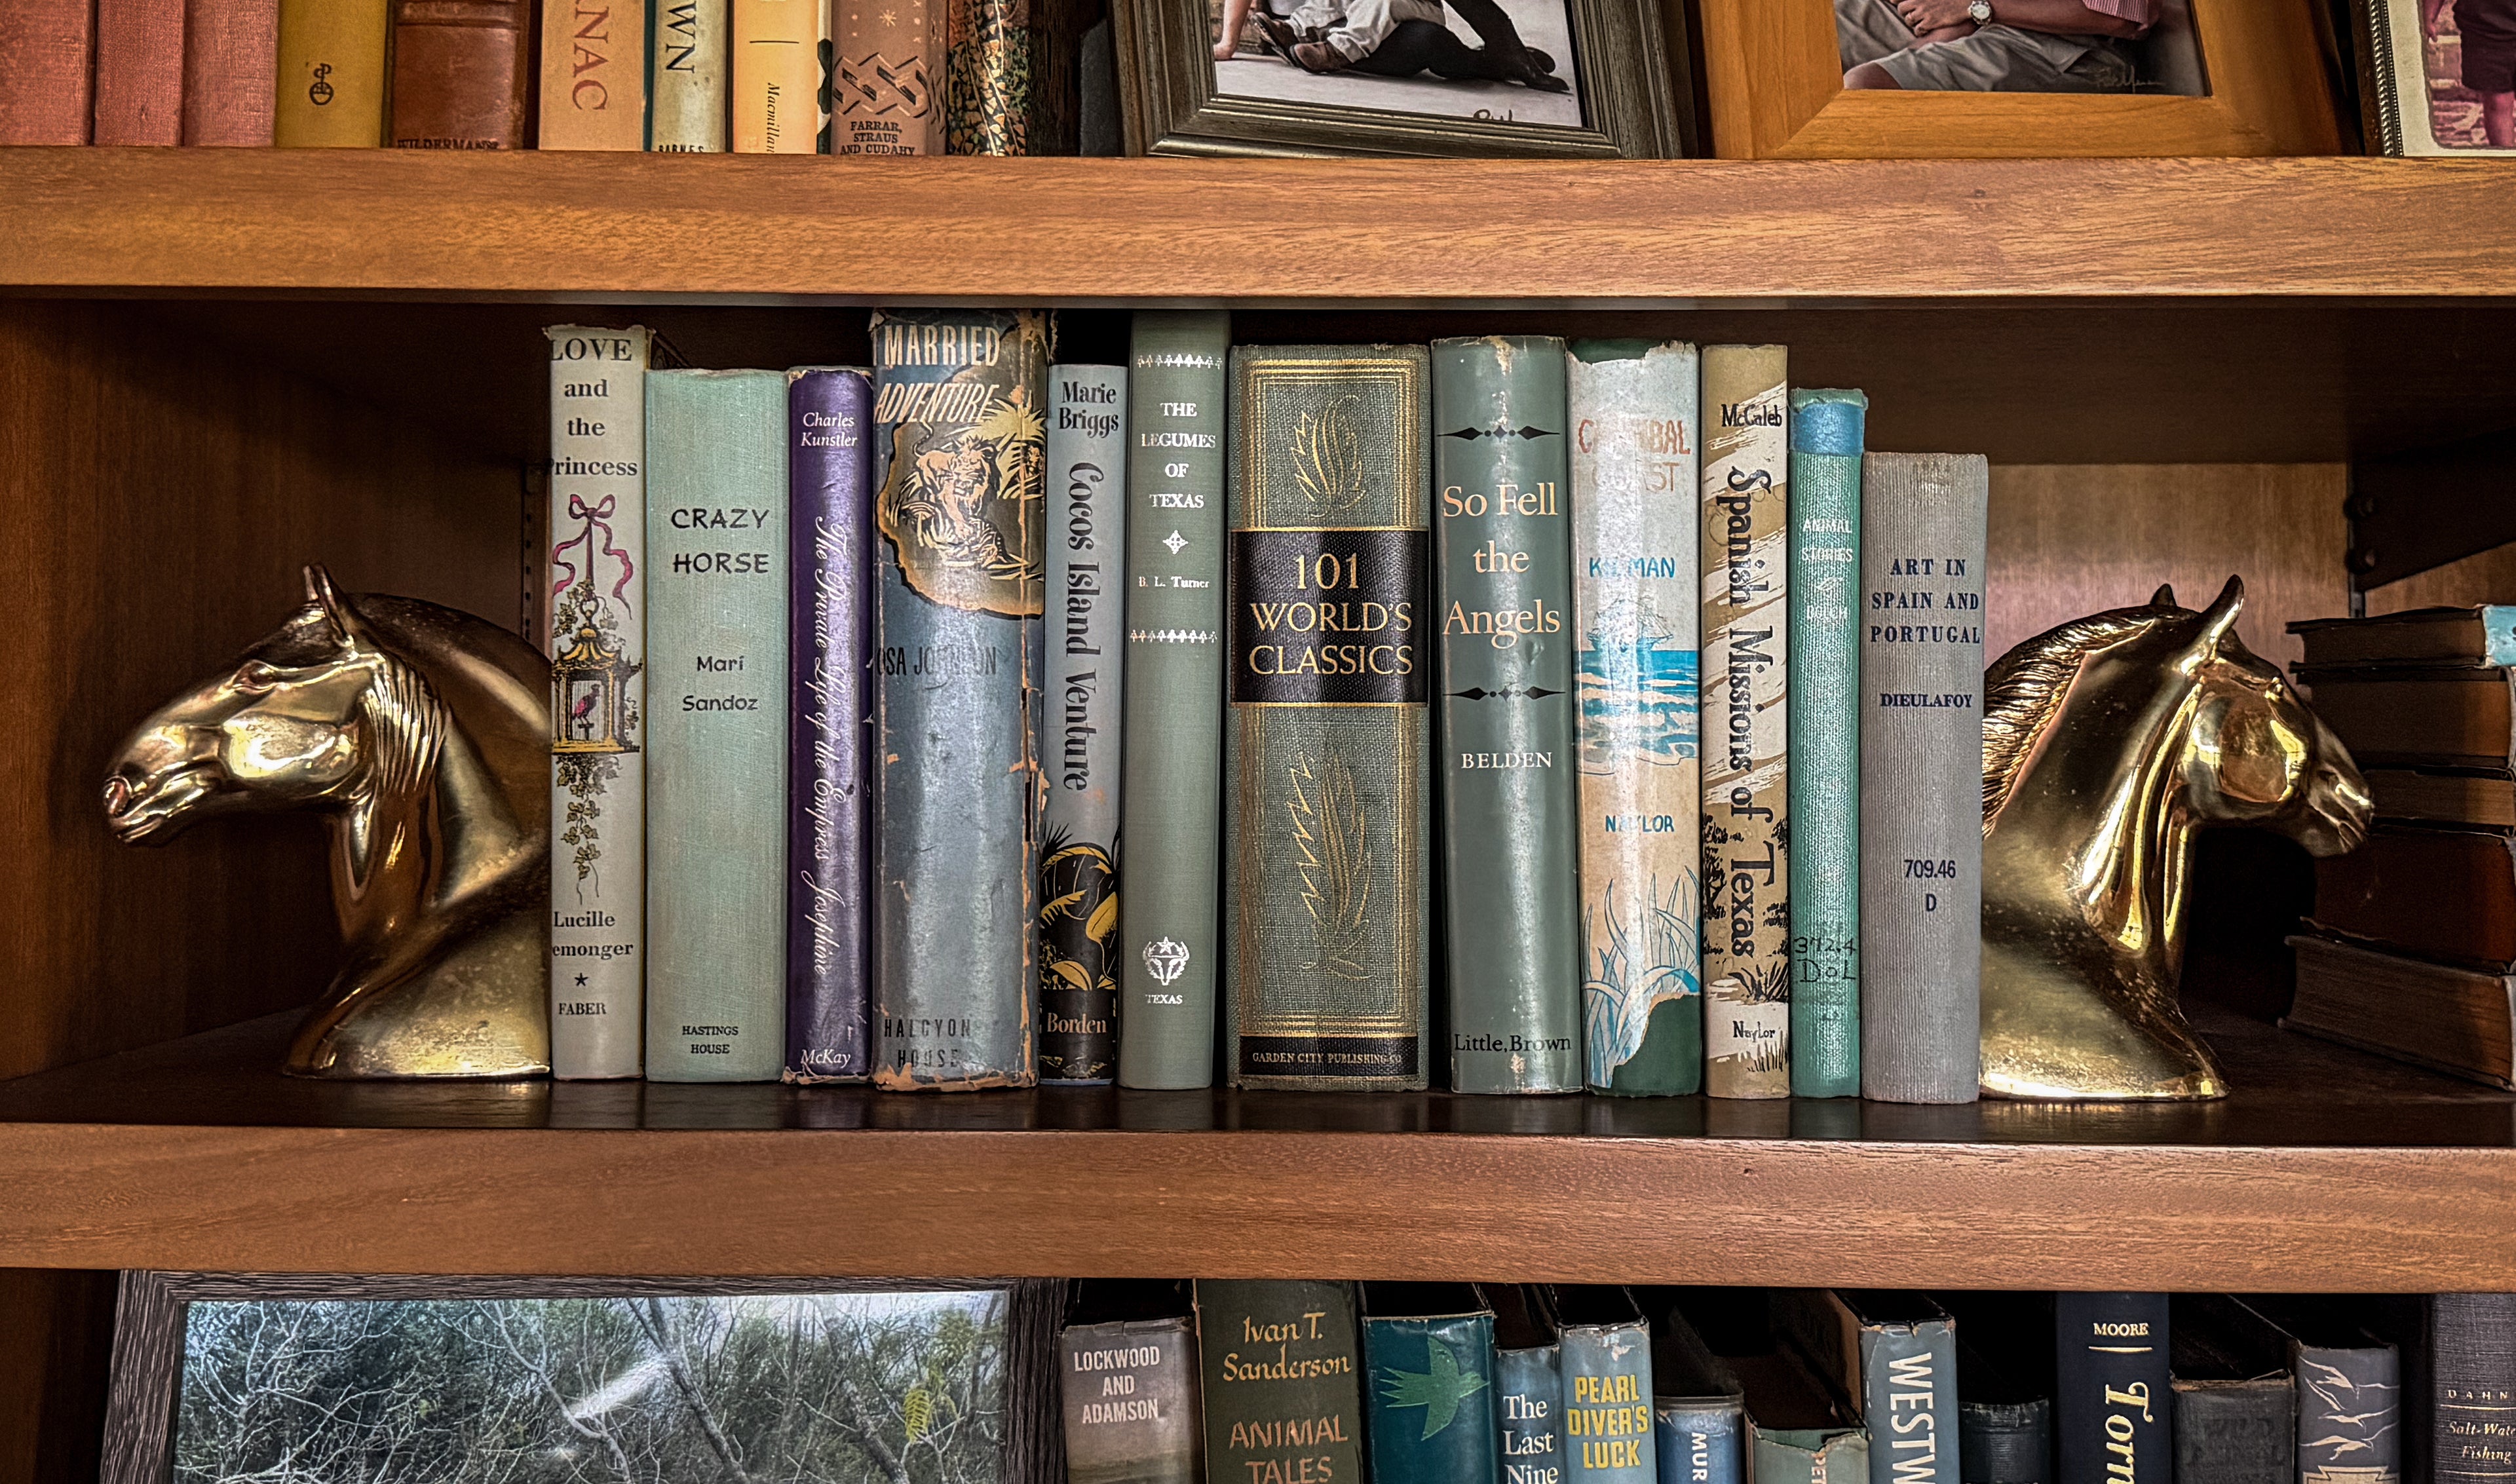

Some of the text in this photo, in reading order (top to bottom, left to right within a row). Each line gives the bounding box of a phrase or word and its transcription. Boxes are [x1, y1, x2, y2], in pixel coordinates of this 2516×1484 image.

[573, 0, 609, 110] NAC
[766, 83, 780, 154] Macmillan
[850, 121, 902, 133] FARRAR,
[854, 132, 898, 143] STRAUS
[840, 144, 915, 155] AND CUDAHY
[550, 338, 632, 361] LOVE
[885, 325, 1000, 367] MARRIED
[564, 379, 609, 398] and
[1062, 381, 1116, 404] Marie
[874, 383, 999, 423] ADVENTURE
[1160, 403, 1197, 417] THE
[803, 412, 855, 427] Charles
[1059, 408, 1119, 438] Briggs
[1721, 404, 1782, 427] McCaleb
[567, 418, 605, 436] the
[801, 432, 858, 447] Kunstler
[1141, 433, 1215, 448] LEGUMES
[1165, 463, 1189, 478] OF
[1149, 493, 1204, 508] TEXAS
[1443, 482, 1558, 517] So Fell
[671, 508, 769, 529] CRAZY
[1802, 518, 1852, 533] ANIMAL
[674, 553, 769, 574] HORSE
[1473, 540, 1529, 573] the
[1802, 548, 1853, 562] STORIES
[1295, 553, 1359, 589] 101
[1890, 559, 1966, 576] ART IN
[1139, 575, 1210, 588] B. L. Turner
[1872, 592, 1979, 610] SPAIN AND
[1063, 463, 1104, 791] Cocos Island Venture
[1249, 602, 1412, 632] WORLD'S
[1442, 599, 1561, 649] Angels
[1871, 626, 1980, 643] PORTUGAL
[1249, 645, 1413, 675] CLASSICS
[682, 695, 758, 712] Sandoz
[1880, 693, 1972, 708] DIEULAFOY
[1716, 466, 1774, 958] Spanish Missions of Texas
[801, 516, 848, 976] The Private Life of the Empress Josephine
[1461, 752, 1552, 769] BELDEN
[1904, 860, 1956, 879] 709.46
[1926, 894, 1937, 911] D
[554, 911, 615, 928] Lucille
[558, 1002, 606, 1015] FABER
[1145, 994, 1183, 1004] TEXAS
[682, 1026, 739, 1035] HASTINGS
[885, 1019, 970, 1037] HALCYON
[1048, 1013, 1107, 1033] Borden
[691, 1044, 730, 1054] HOUSE
[801, 1049, 851, 1069] McKay
[1253, 1053, 1295, 1063] GARDEN
[1298, 1053, 1324, 1063] CITY
[1244, 1312, 1325, 1344] Ivan T.
[2093, 1323, 2149, 1336] MOORE
[1075, 1346, 1160, 1372] LOCKWOOD
[1223, 1344, 1351, 1381] Sanderson
[1102, 1375, 1135, 1396] AND
[1575, 1375, 1640, 1403] PEARL
[1082, 1398, 1158, 1424] ADAMSON
[1503, 1394, 1547, 1419] The
[1567, 1405, 1649, 1437] DIVER'S
[1229, 1415, 1348, 1449] ANIMAL
[1503, 1430, 1553, 1455] Last
[1583, 1439, 1641, 1469] LUCK
[2462, 1445, 2511, 1464] Fishing
[1246, 1456, 1333, 1484] TALES
[1504, 1464, 1558, 1484] Nine
